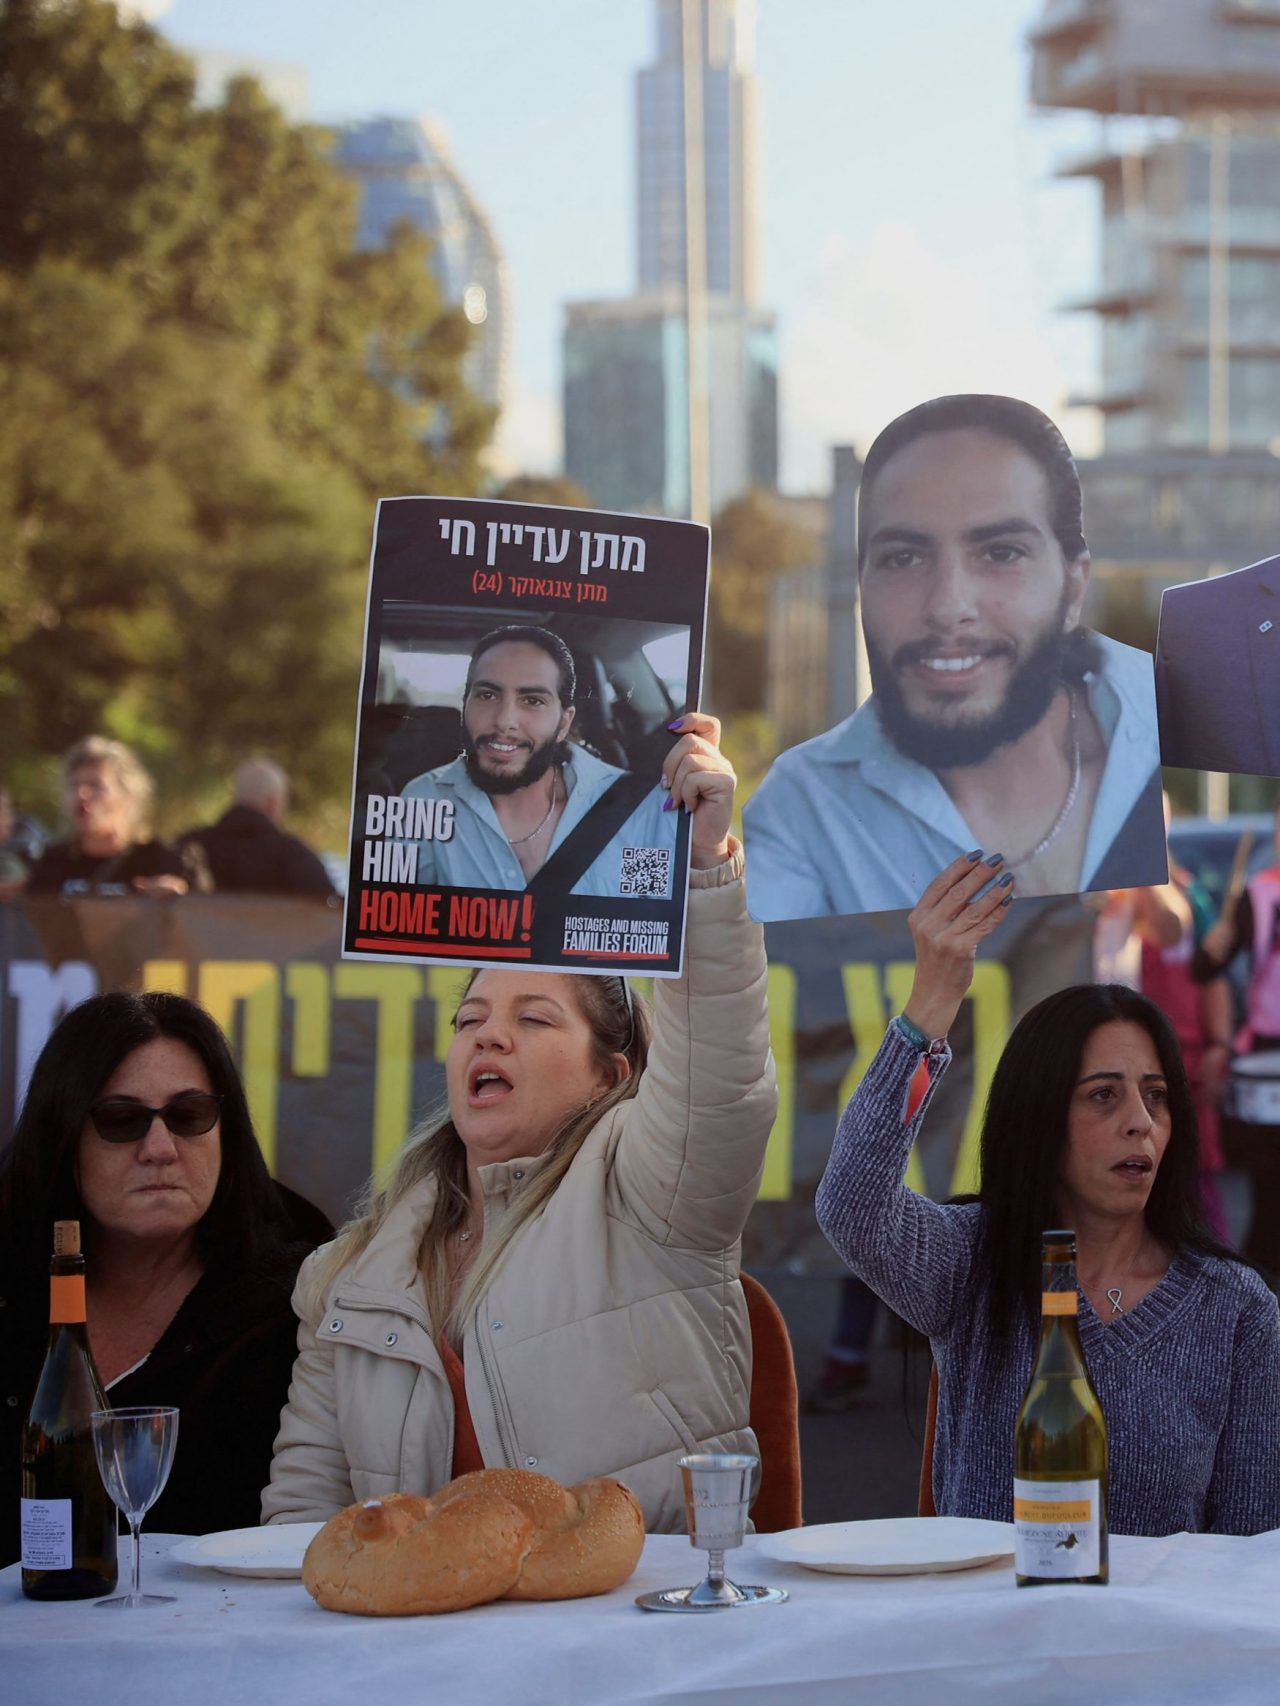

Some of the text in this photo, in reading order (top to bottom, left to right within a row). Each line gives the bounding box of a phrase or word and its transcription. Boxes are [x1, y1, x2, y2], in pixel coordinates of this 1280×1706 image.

[438, 518, 646, 575] מתן עדיין חי
[472, 569, 608, 603] מתן צנגאוקר (24)
[365, 794, 454, 841] BRING
[362, 840, 418, 884] HIM
[359, 889, 534, 942] HOME NOW!
[564, 916, 669, 935] HOSTAGES AND MISSING
[563, 931, 668, 955] FAMILIES FORUM
